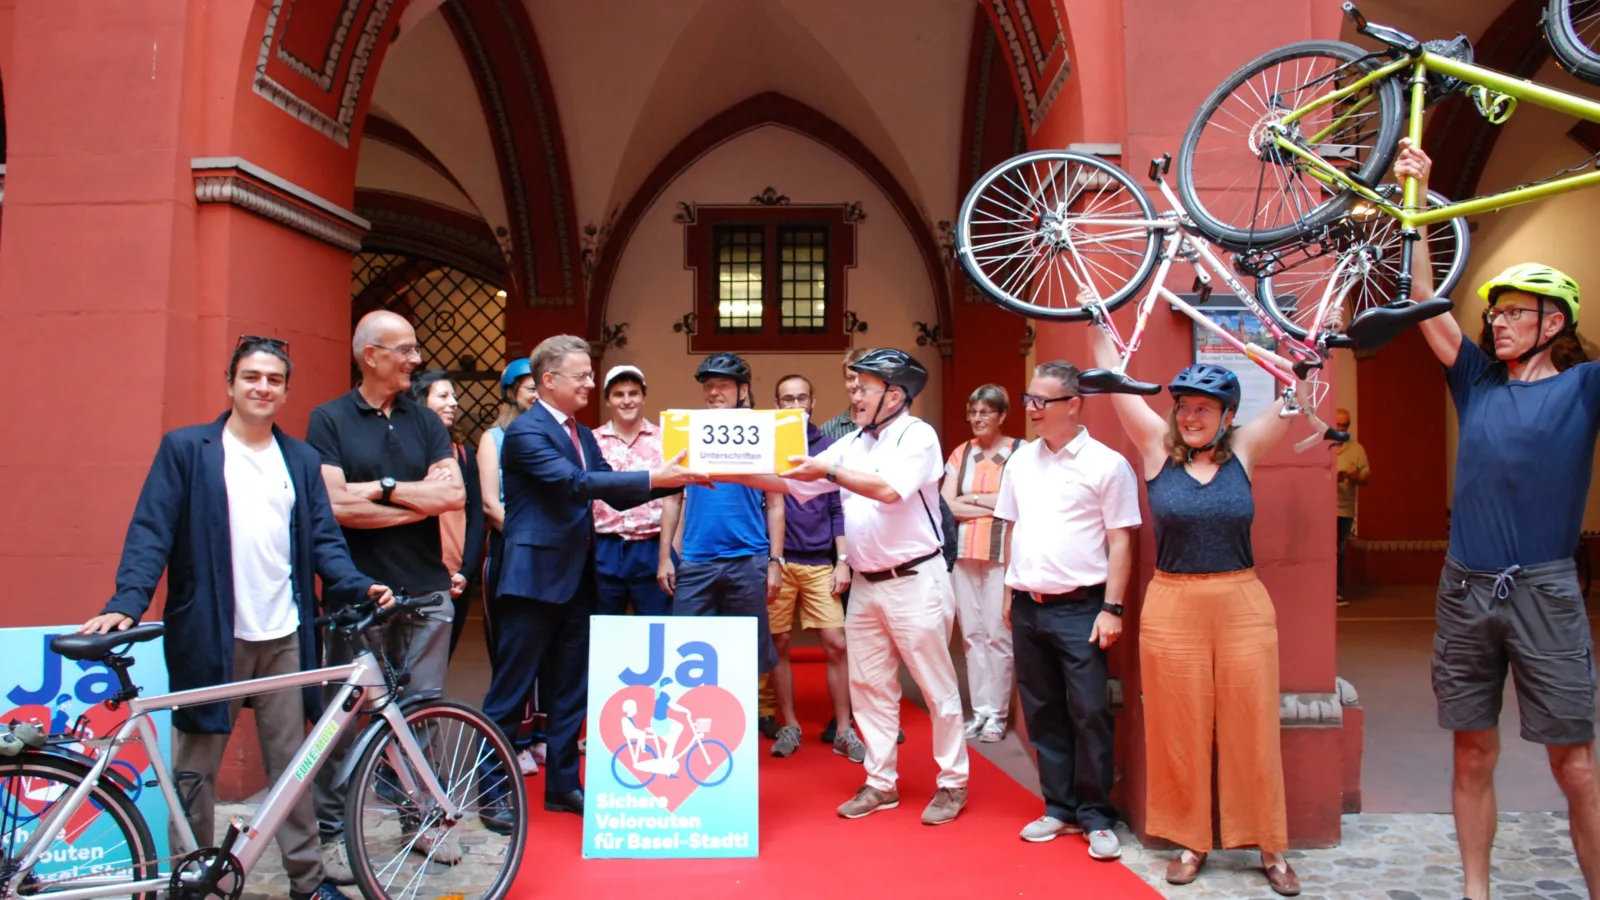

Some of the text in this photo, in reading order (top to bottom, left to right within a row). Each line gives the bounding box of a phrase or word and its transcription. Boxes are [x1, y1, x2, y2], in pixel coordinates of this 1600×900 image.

[702, 424, 760, 445] 3333
[700, 451, 762, 460] Unterschriften
[618, 623, 718, 687] Ja
[6, 634, 119, 706] Ja
[595, 793, 669, 809] Sichere
[595, 813, 701, 829] Velorouten
[594, 832, 749, 850] für Basel-Stadt!
